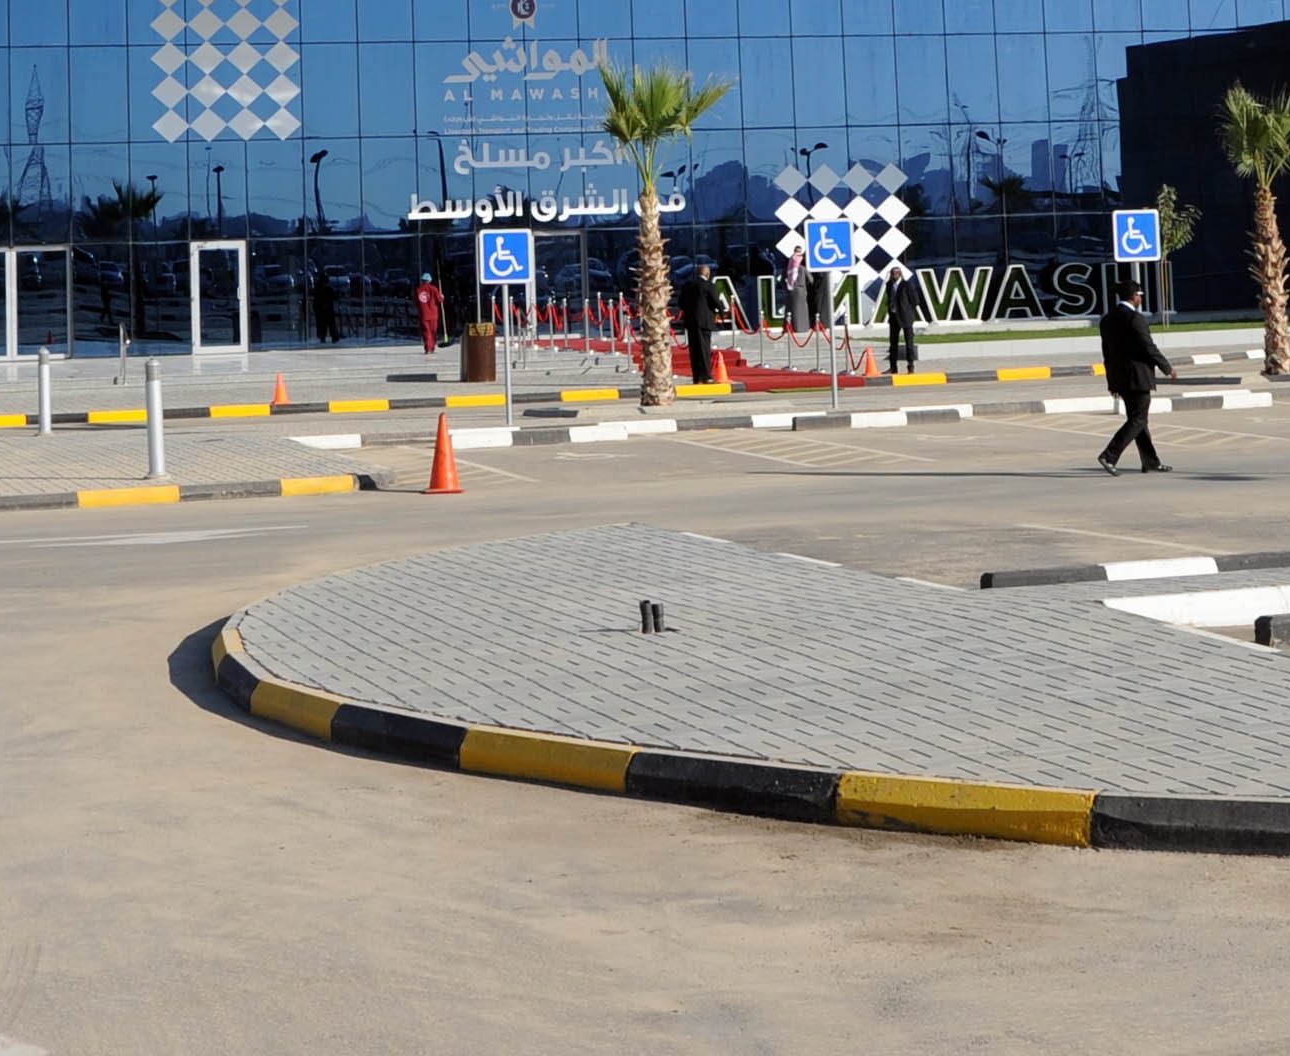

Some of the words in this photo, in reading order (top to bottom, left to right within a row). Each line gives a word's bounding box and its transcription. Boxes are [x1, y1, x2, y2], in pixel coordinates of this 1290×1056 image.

[443, 35, 608, 84] المواشي
[444, 89, 473, 102] AL
[491, 87, 611, 102] MAWASH
[454, 138, 551, 176] مسلخ
[408, 186, 523, 224] الأوسط
[530, 183, 628, 223] الشرق
